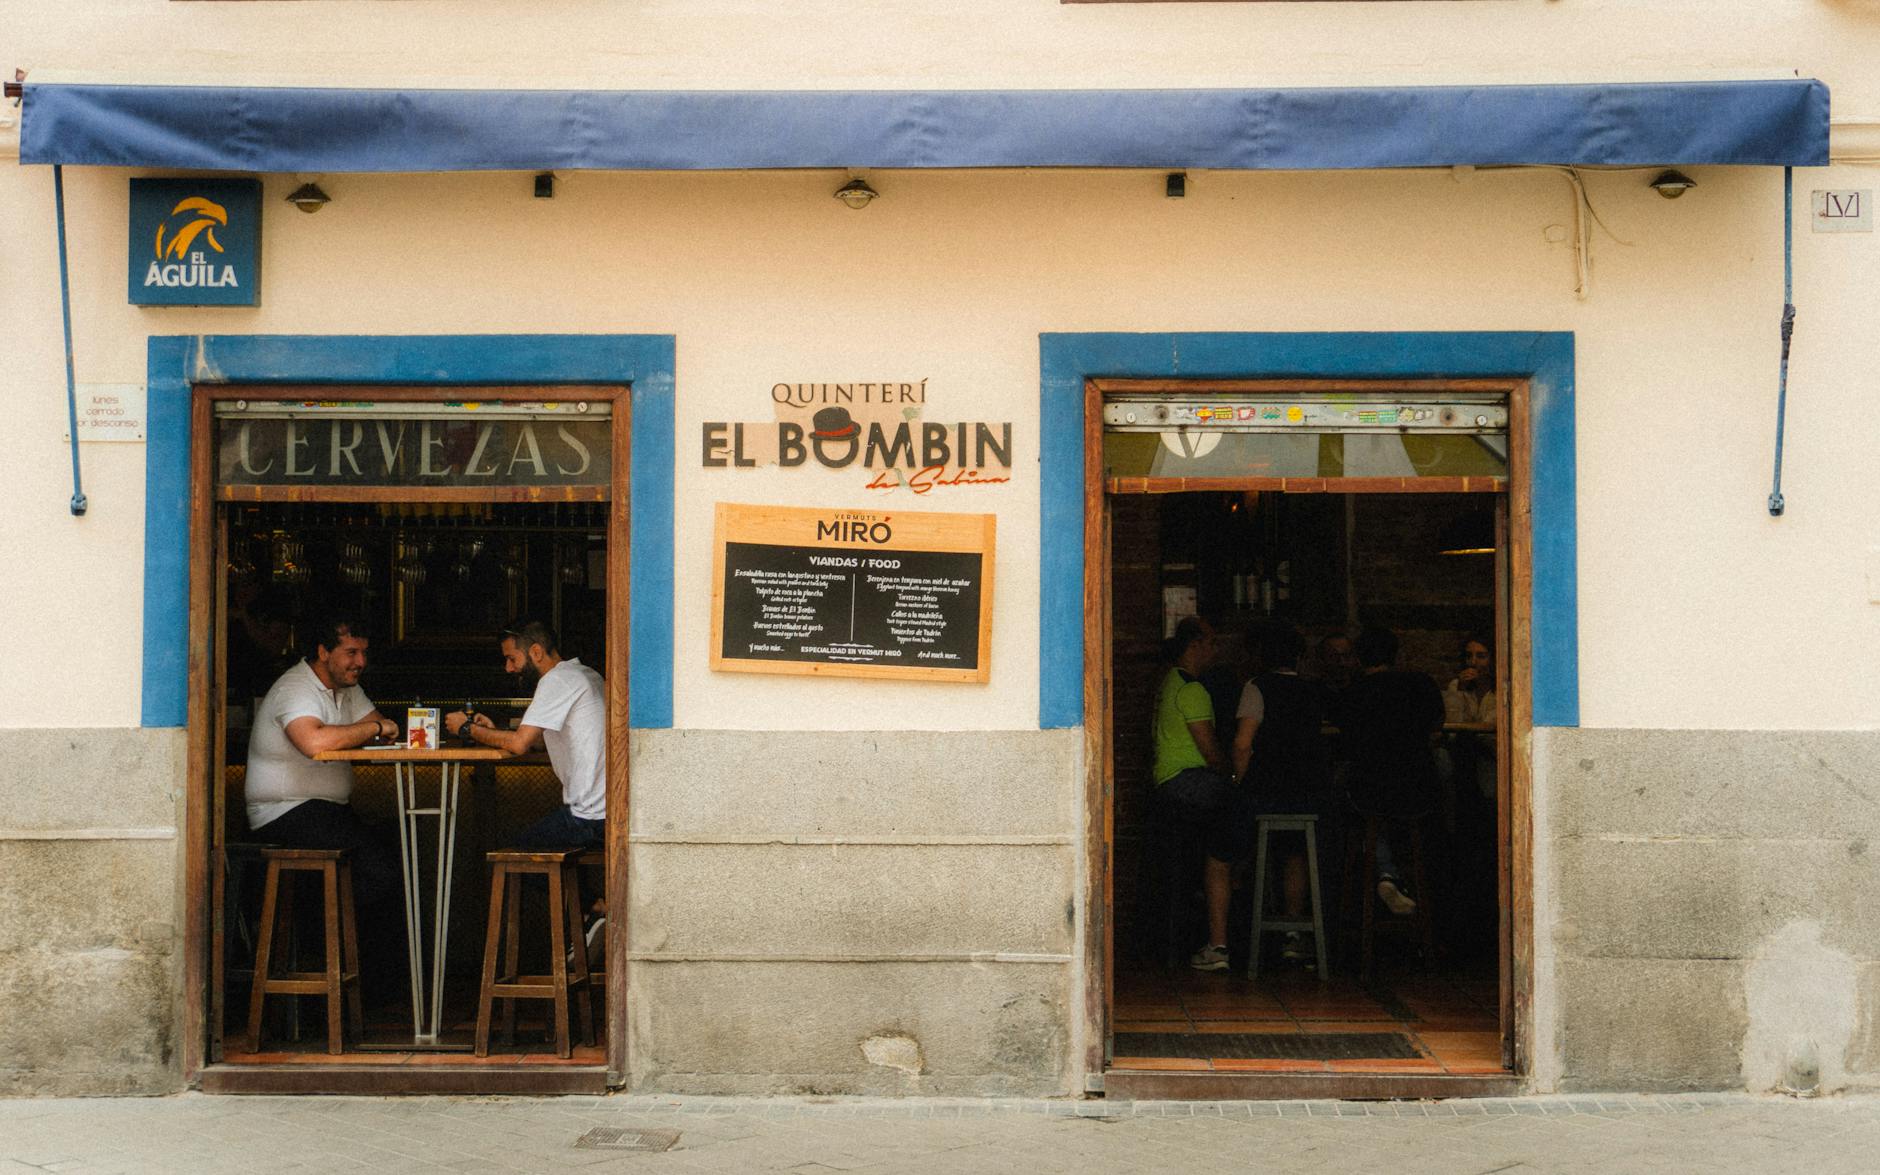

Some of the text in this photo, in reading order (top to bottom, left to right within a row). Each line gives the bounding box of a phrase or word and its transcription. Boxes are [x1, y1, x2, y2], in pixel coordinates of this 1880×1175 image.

[192, 251, 206, 264] EL
[144, 261, 238, 287] ÁGUILA
[771, 377, 929, 409] QUINTERÍ
[93, 396, 119, 404] lunes
[87, 408, 124, 416] cerrado
[91, 419, 138, 428] descanso
[240, 421, 589, 476] CERVEZAS
[702, 421, 1012, 469] EL BOMBIN
[909, 464, 1010, 495] Sabina
[834, 513, 877, 521] VERMUTS
[817, 516, 892, 544] MIRÓ
[809, 556, 858, 568] VIANDAS
[868, 559, 901, 569] FOOD
[800, 646, 846, 655] ESPECIALIDAD
[857, 648, 884, 656] VERMUT
